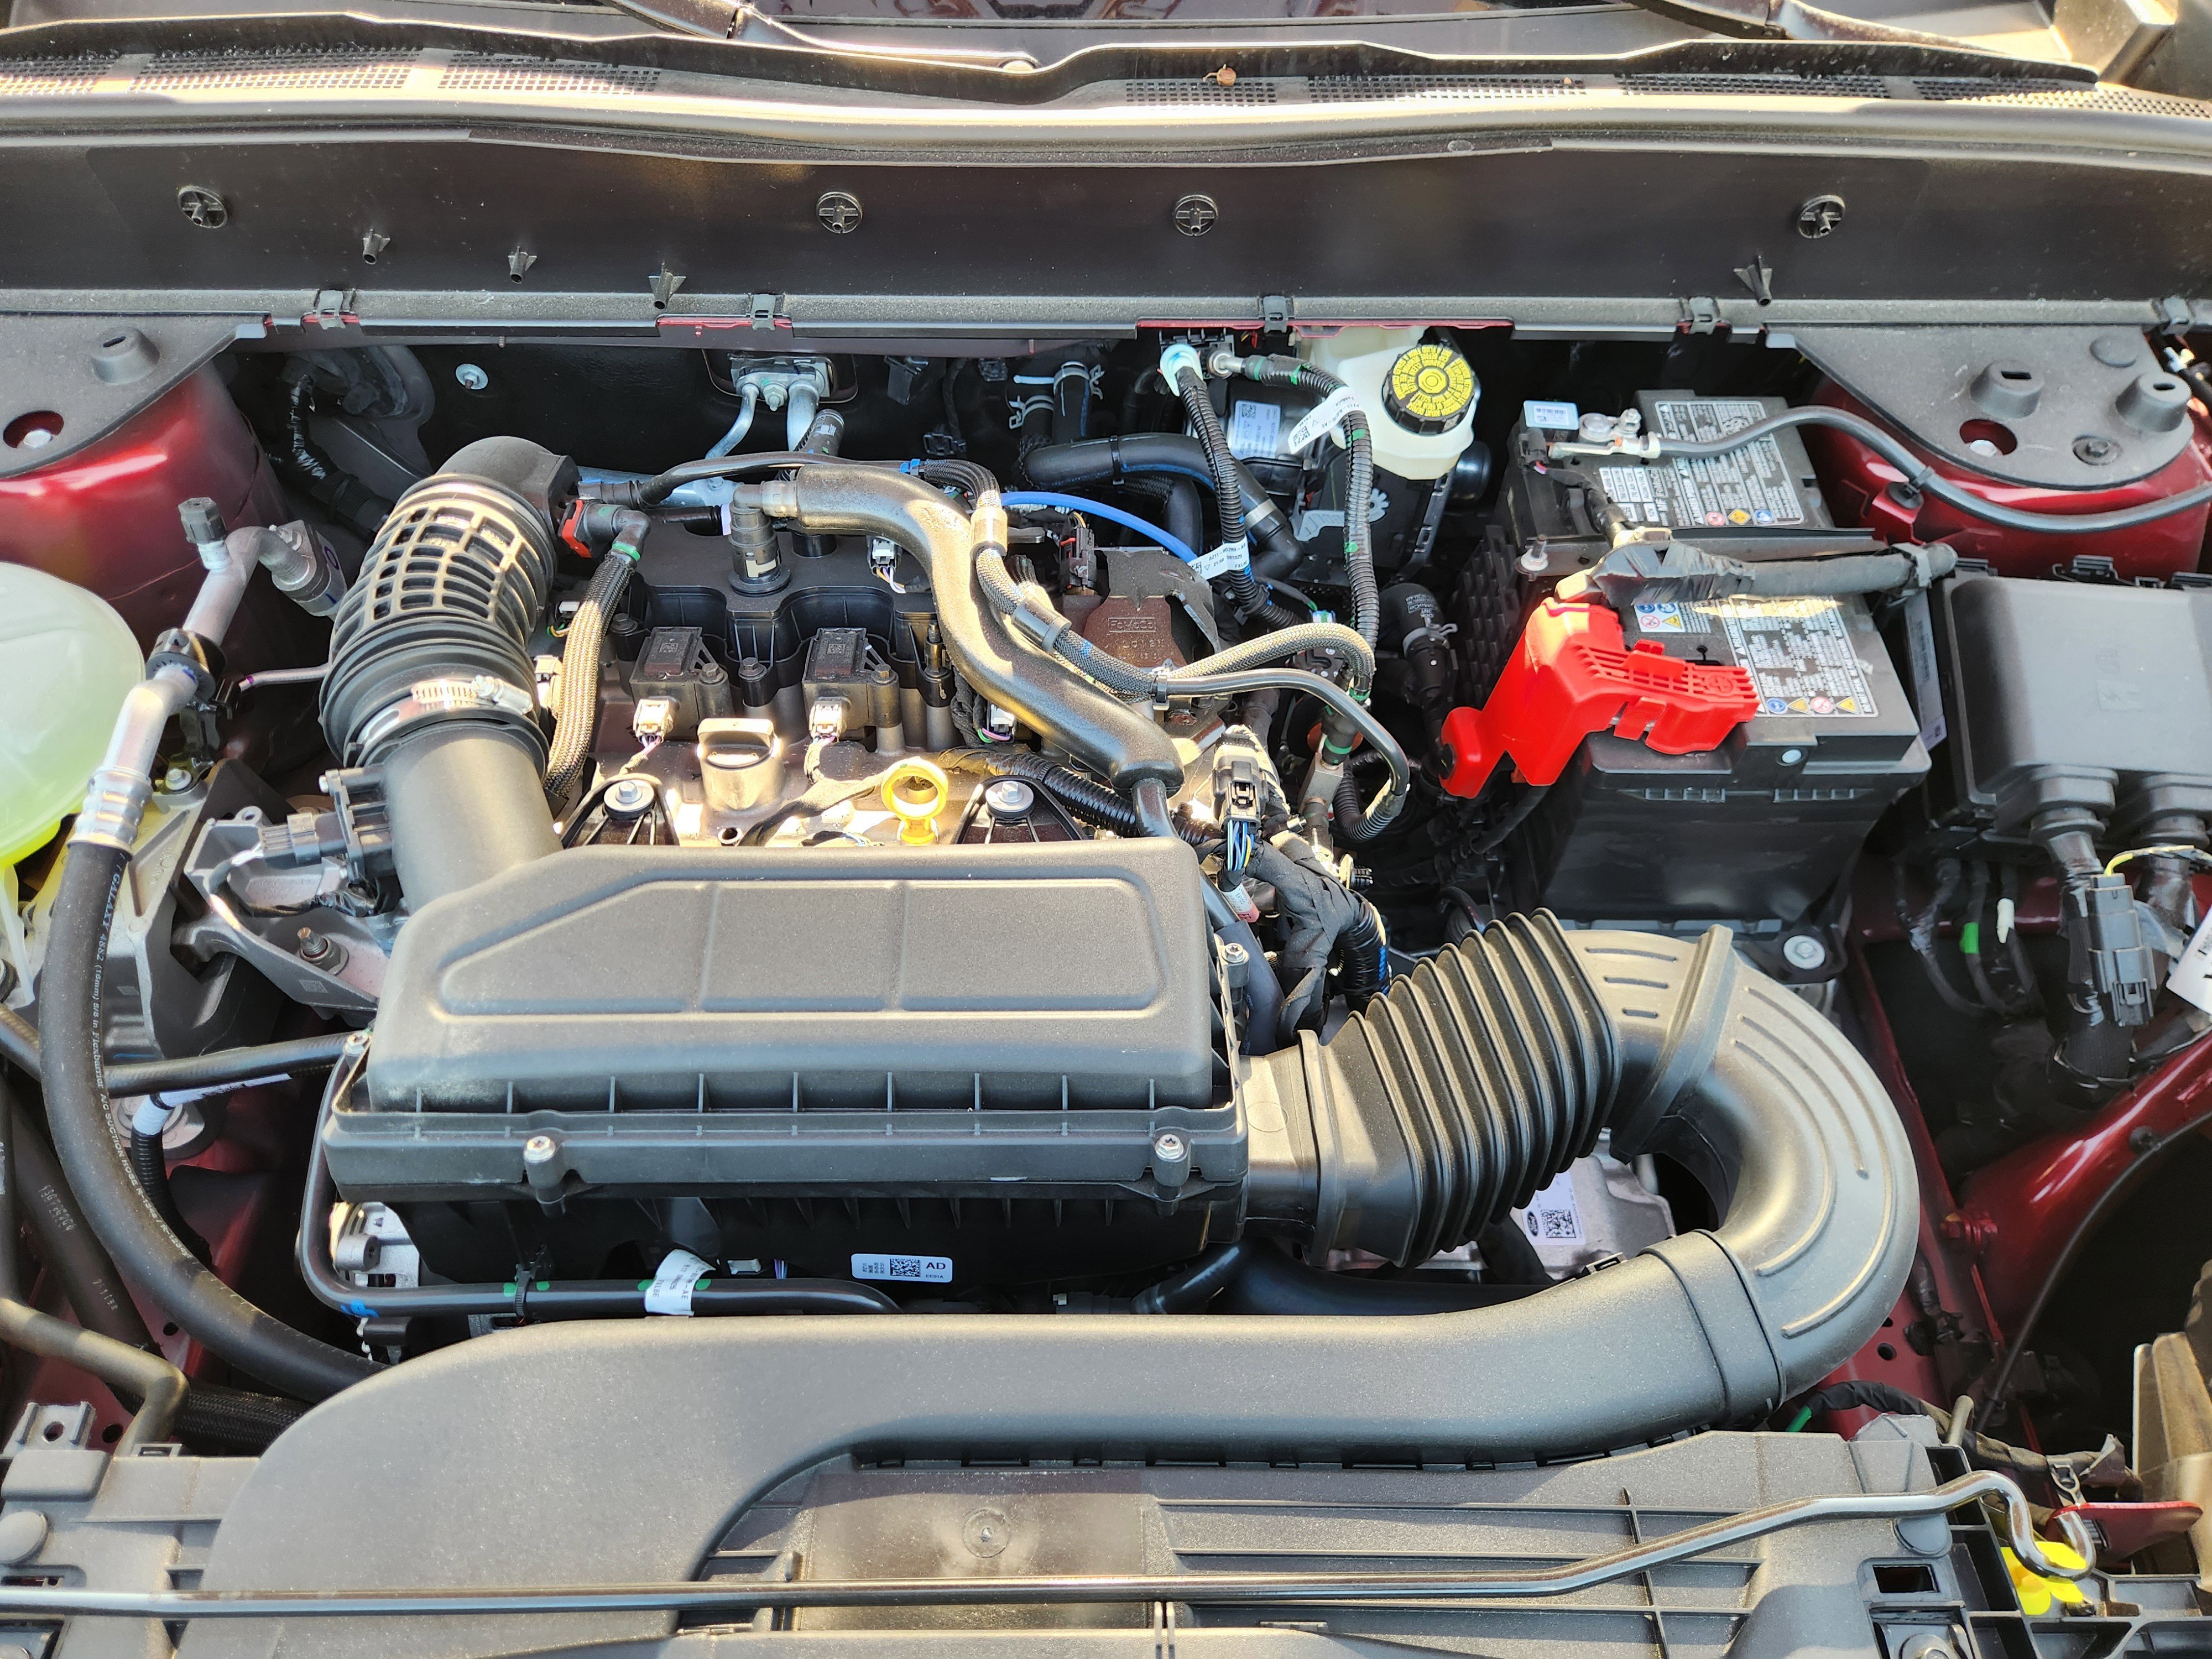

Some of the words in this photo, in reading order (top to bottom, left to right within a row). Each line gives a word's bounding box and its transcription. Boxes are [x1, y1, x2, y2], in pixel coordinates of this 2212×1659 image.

[102, 873, 120, 932] GALAXY
[96, 933, 107, 961] 4882
[92, 964, 102, 1000] (16mm)
[92, 1002, 101, 1018] 5/8
[100, 1093, 109, 1111] A/C
[105, 1113, 125, 1157] SUCTION
[121, 1159, 139, 1186] HOSE
